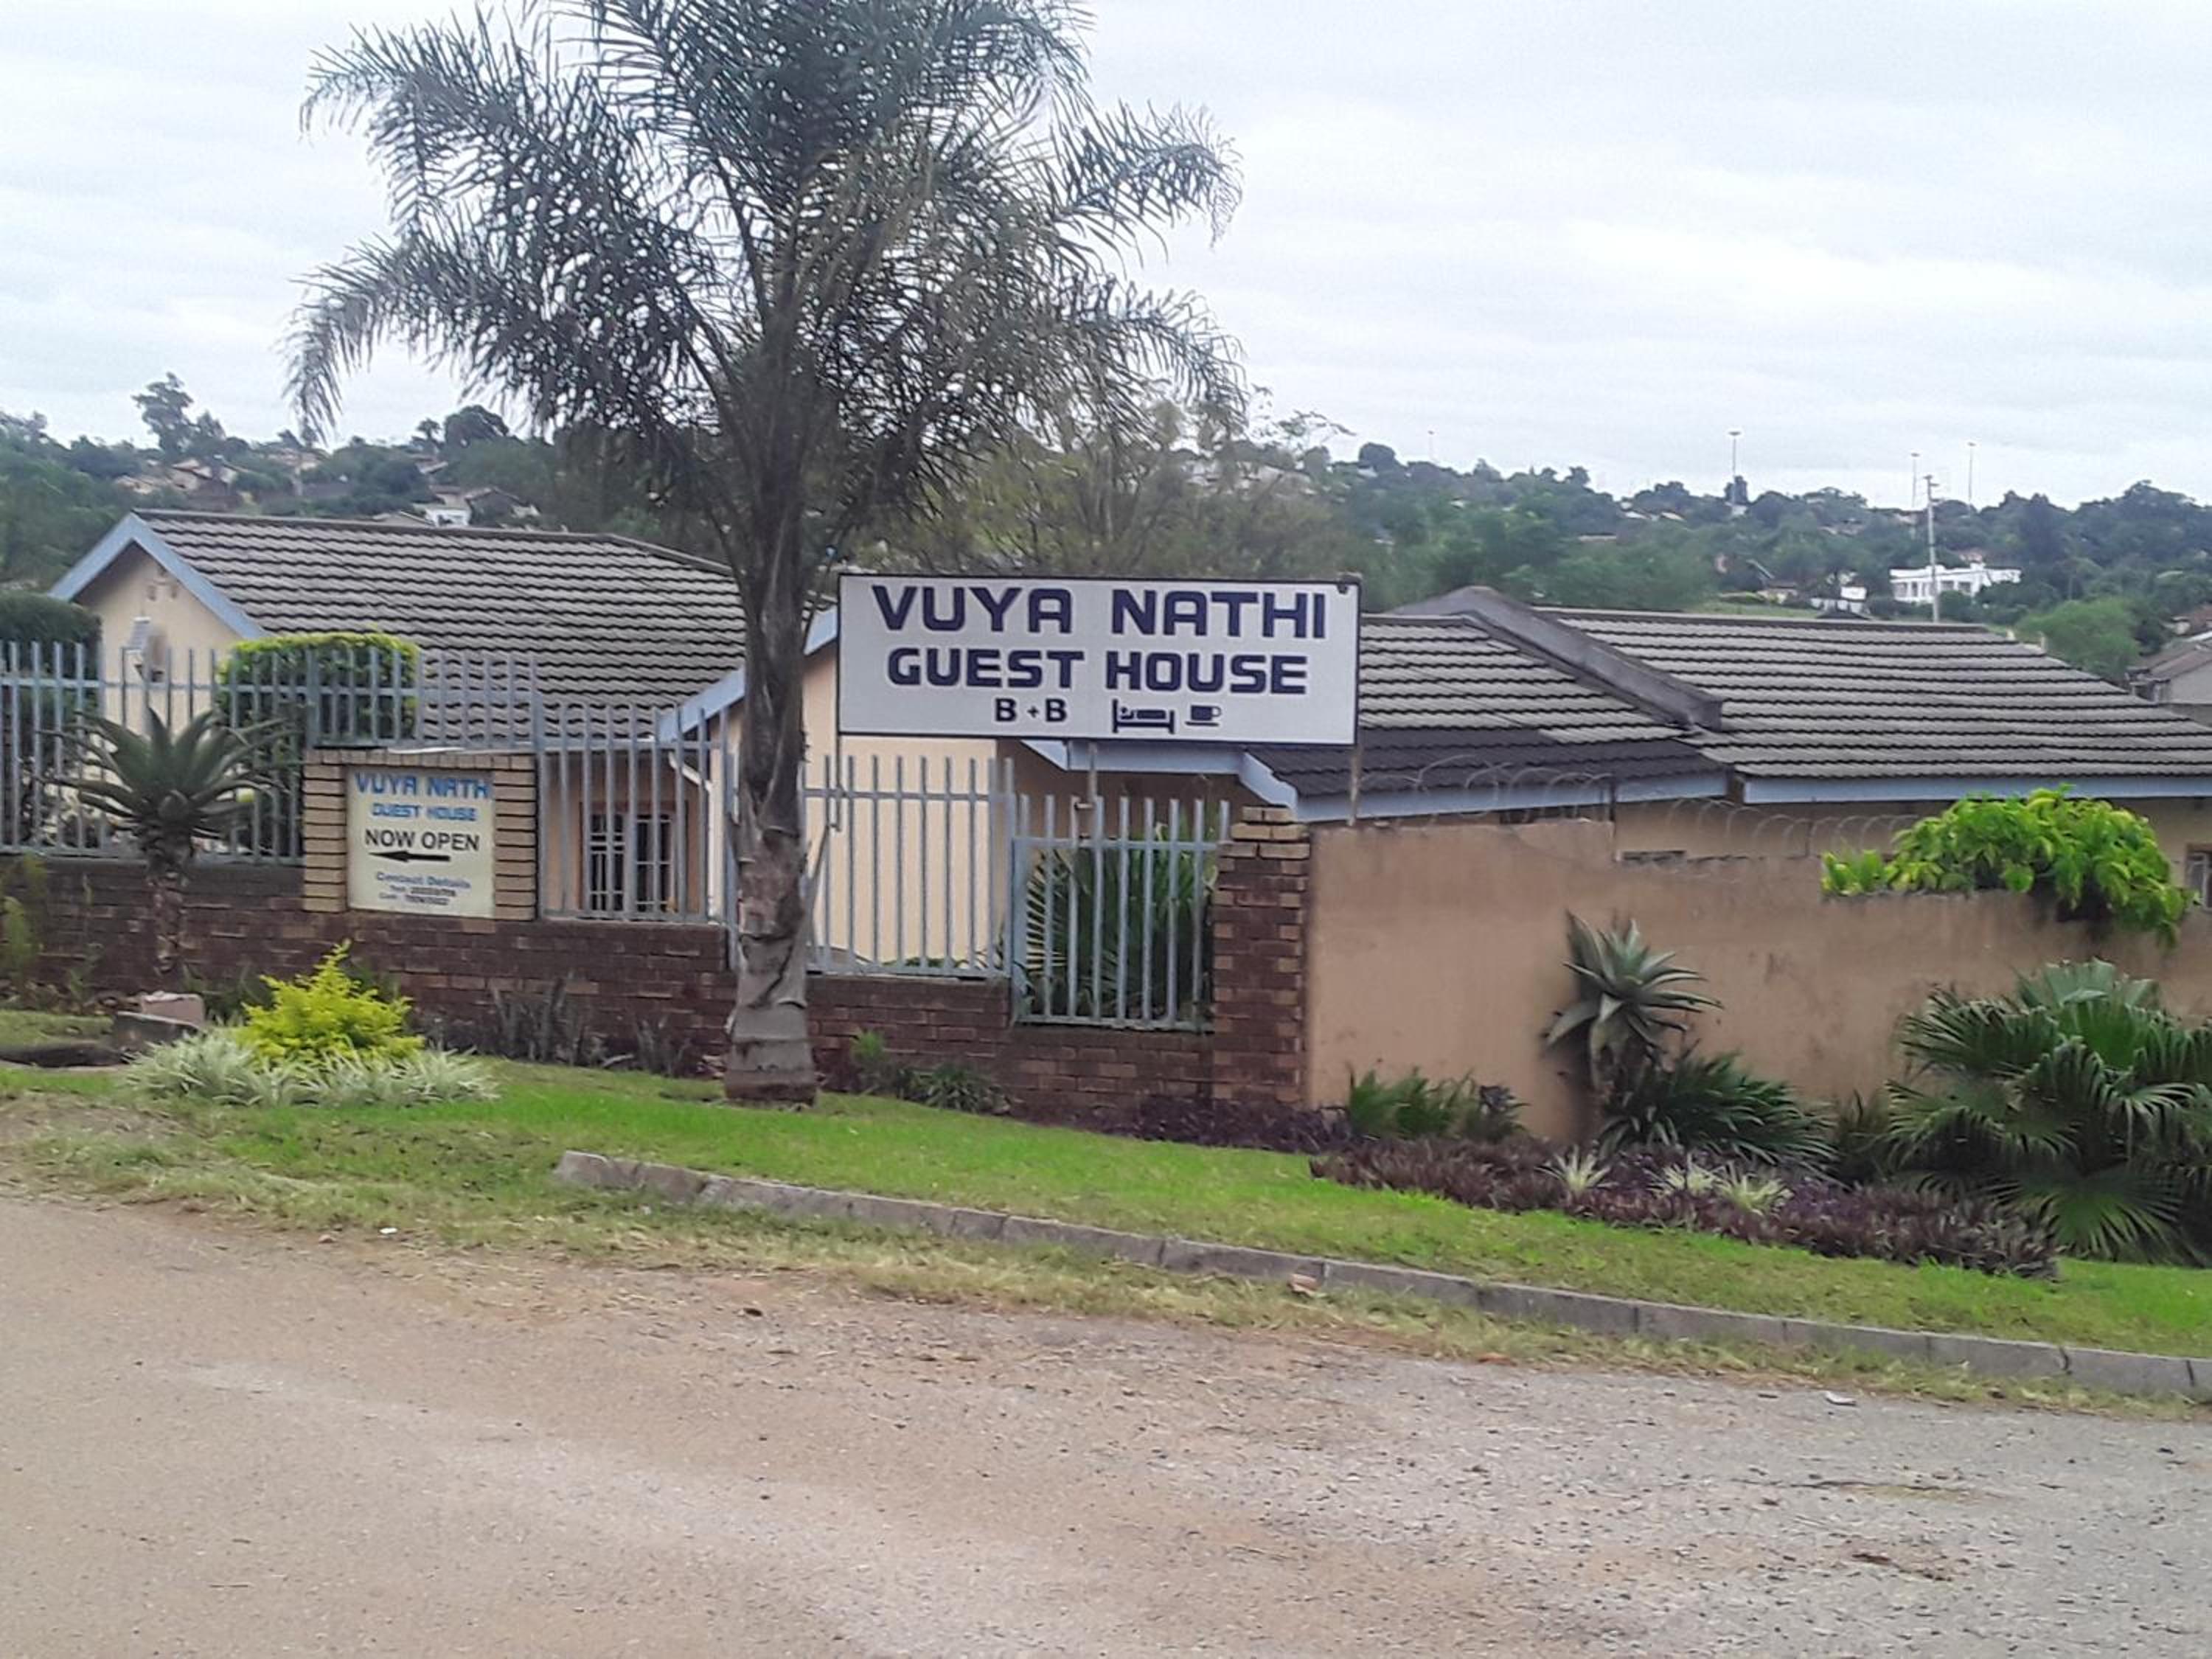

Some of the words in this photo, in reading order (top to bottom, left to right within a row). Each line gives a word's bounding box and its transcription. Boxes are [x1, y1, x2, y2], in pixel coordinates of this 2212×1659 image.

[872, 585, 1071, 633] VUYA
[1111, 588, 1326, 639] NATHI
[888, 647, 1085, 689] GUEST
[1106, 650, 1307, 695] HOUSE
[355, 772, 417, 796] VUYA
[365, 829, 416, 848] NOW
[421, 831, 479, 851] OPEN
